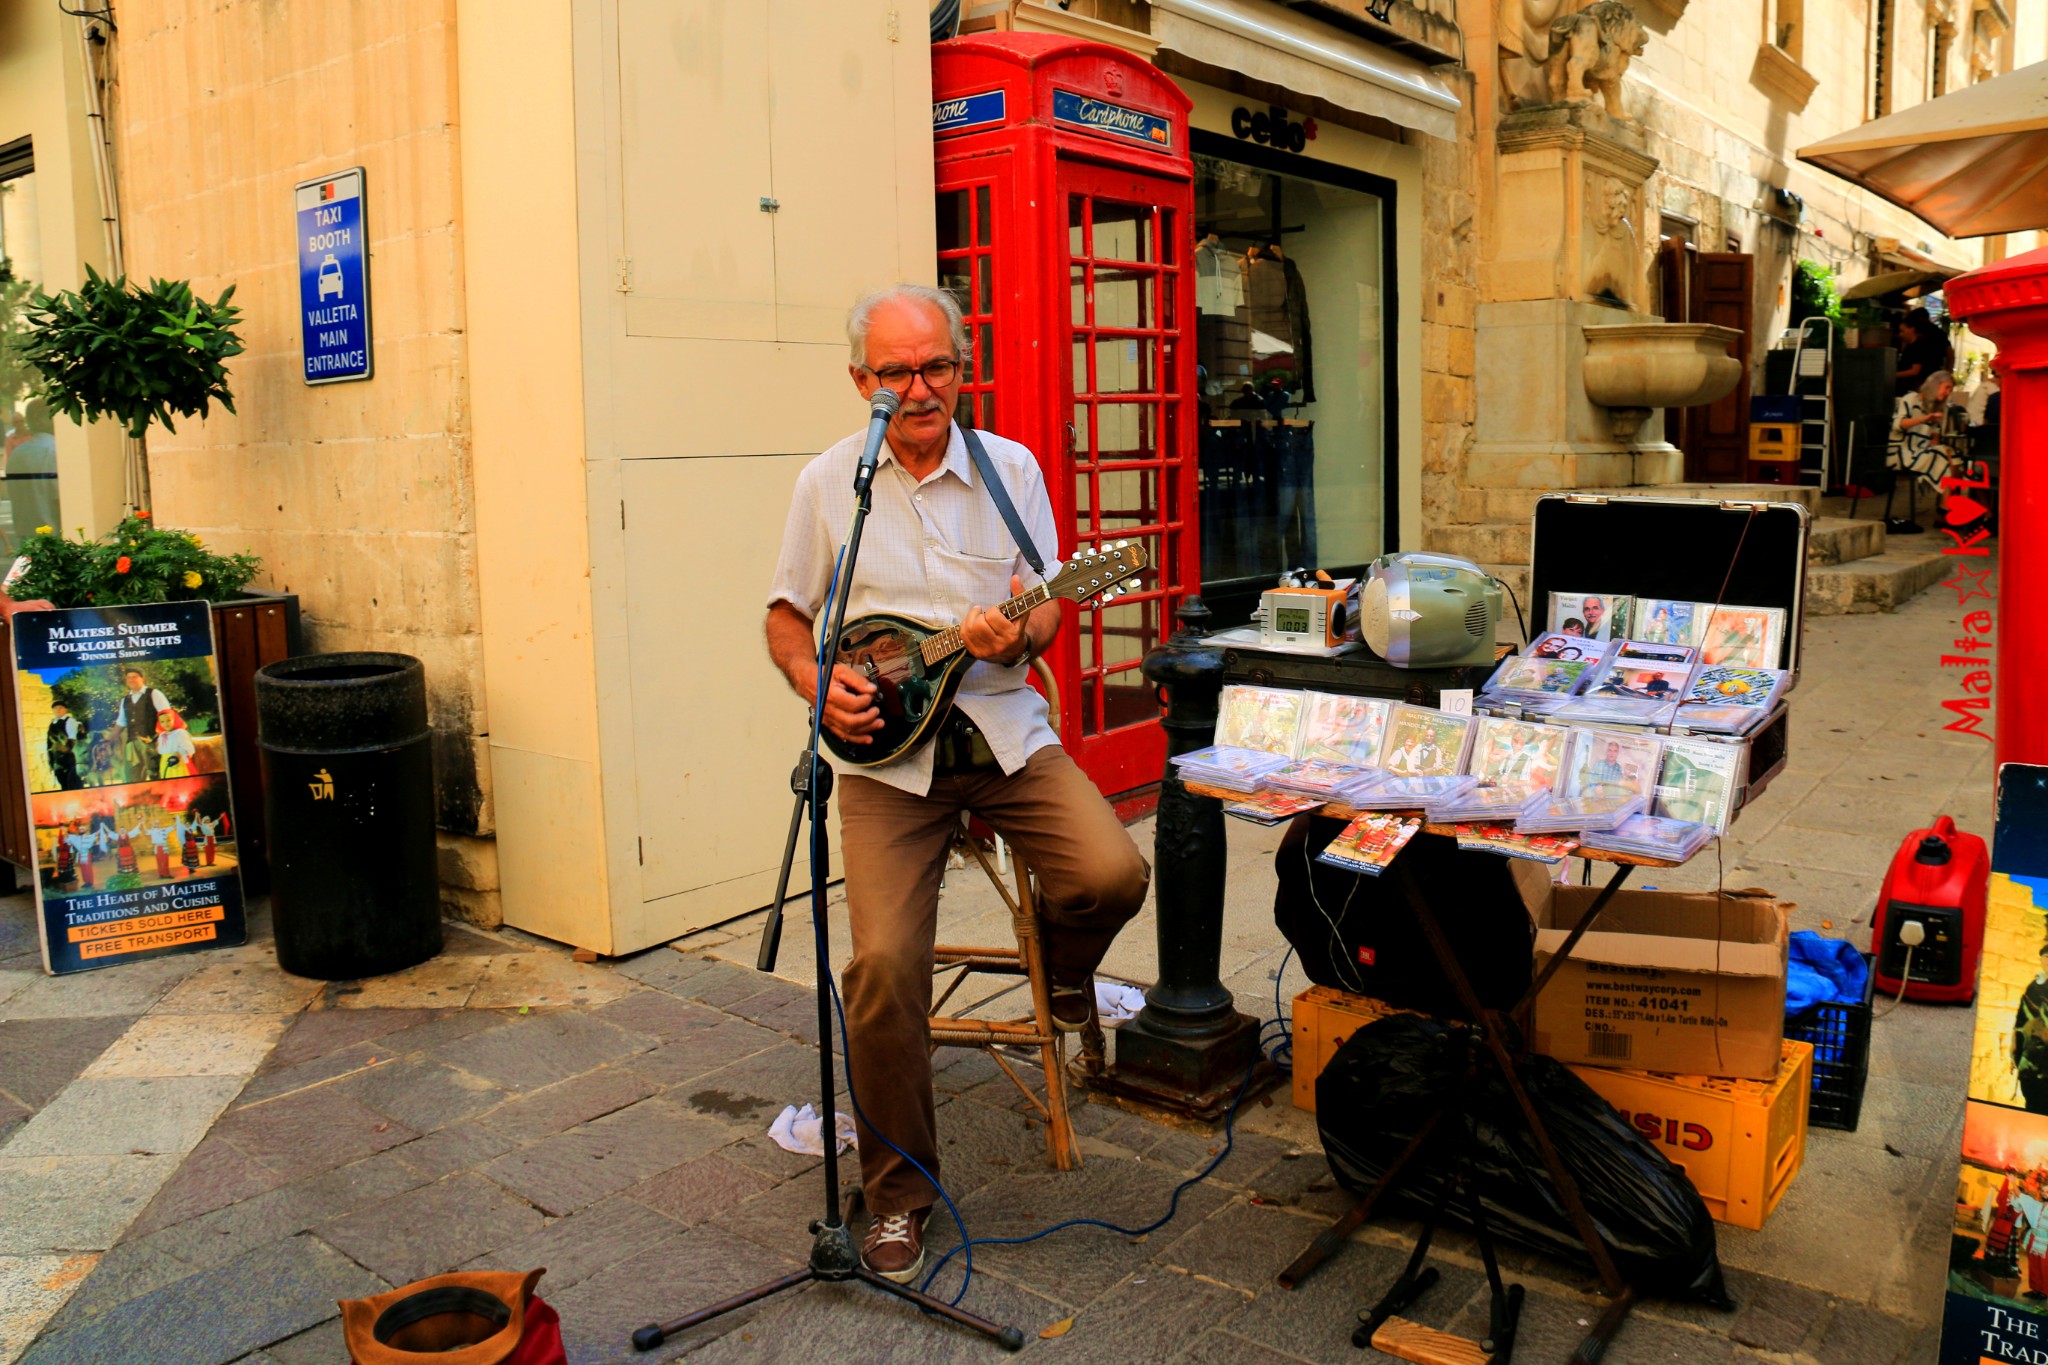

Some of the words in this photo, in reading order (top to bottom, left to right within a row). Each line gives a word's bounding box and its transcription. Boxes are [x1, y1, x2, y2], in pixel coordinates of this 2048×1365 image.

[1080, 102, 1144, 130] Cardphone
[314, 205, 342, 228] TAXI
[308, 228, 351, 252] BOOTH
[308, 303, 358, 327] VALLETTA
[319, 328, 348, 348] MAIN
[307, 350, 365, 373] ENTRANCE
[48, 626, 115, 640] MALTESE
[118, 622, 178, 636] SUMMER
[47, 638, 125, 654] FOLKLORE
[127, 634, 182, 649] NIGHTS
[1449, 697, 1465, 712] 10
[66, 898, 94, 911] THE
[97, 892, 140, 906] HEART
[142, 889, 159, 900] OF
[162, 882, 217, 898] MALTESE
[65, 906, 140, 926] TRADITIONS
[143, 901, 169, 914] AND
[172, 894, 220, 910] CUISINE
[78, 921, 134, 938] TICKETS
[139, 915, 173, 928] SOLD
[178, 909, 213, 923] HERE
[86, 940, 122, 955] FREE
[128, 926, 211, 949] TRANSPORT
[1586, 982, 1702, 997] www.bestwaycorp.com
[1585, 996, 1610, 1006] ITEM
[1638, 997, 1689, 1012] 41041
[1987, 1306, 2039, 1340] THE
